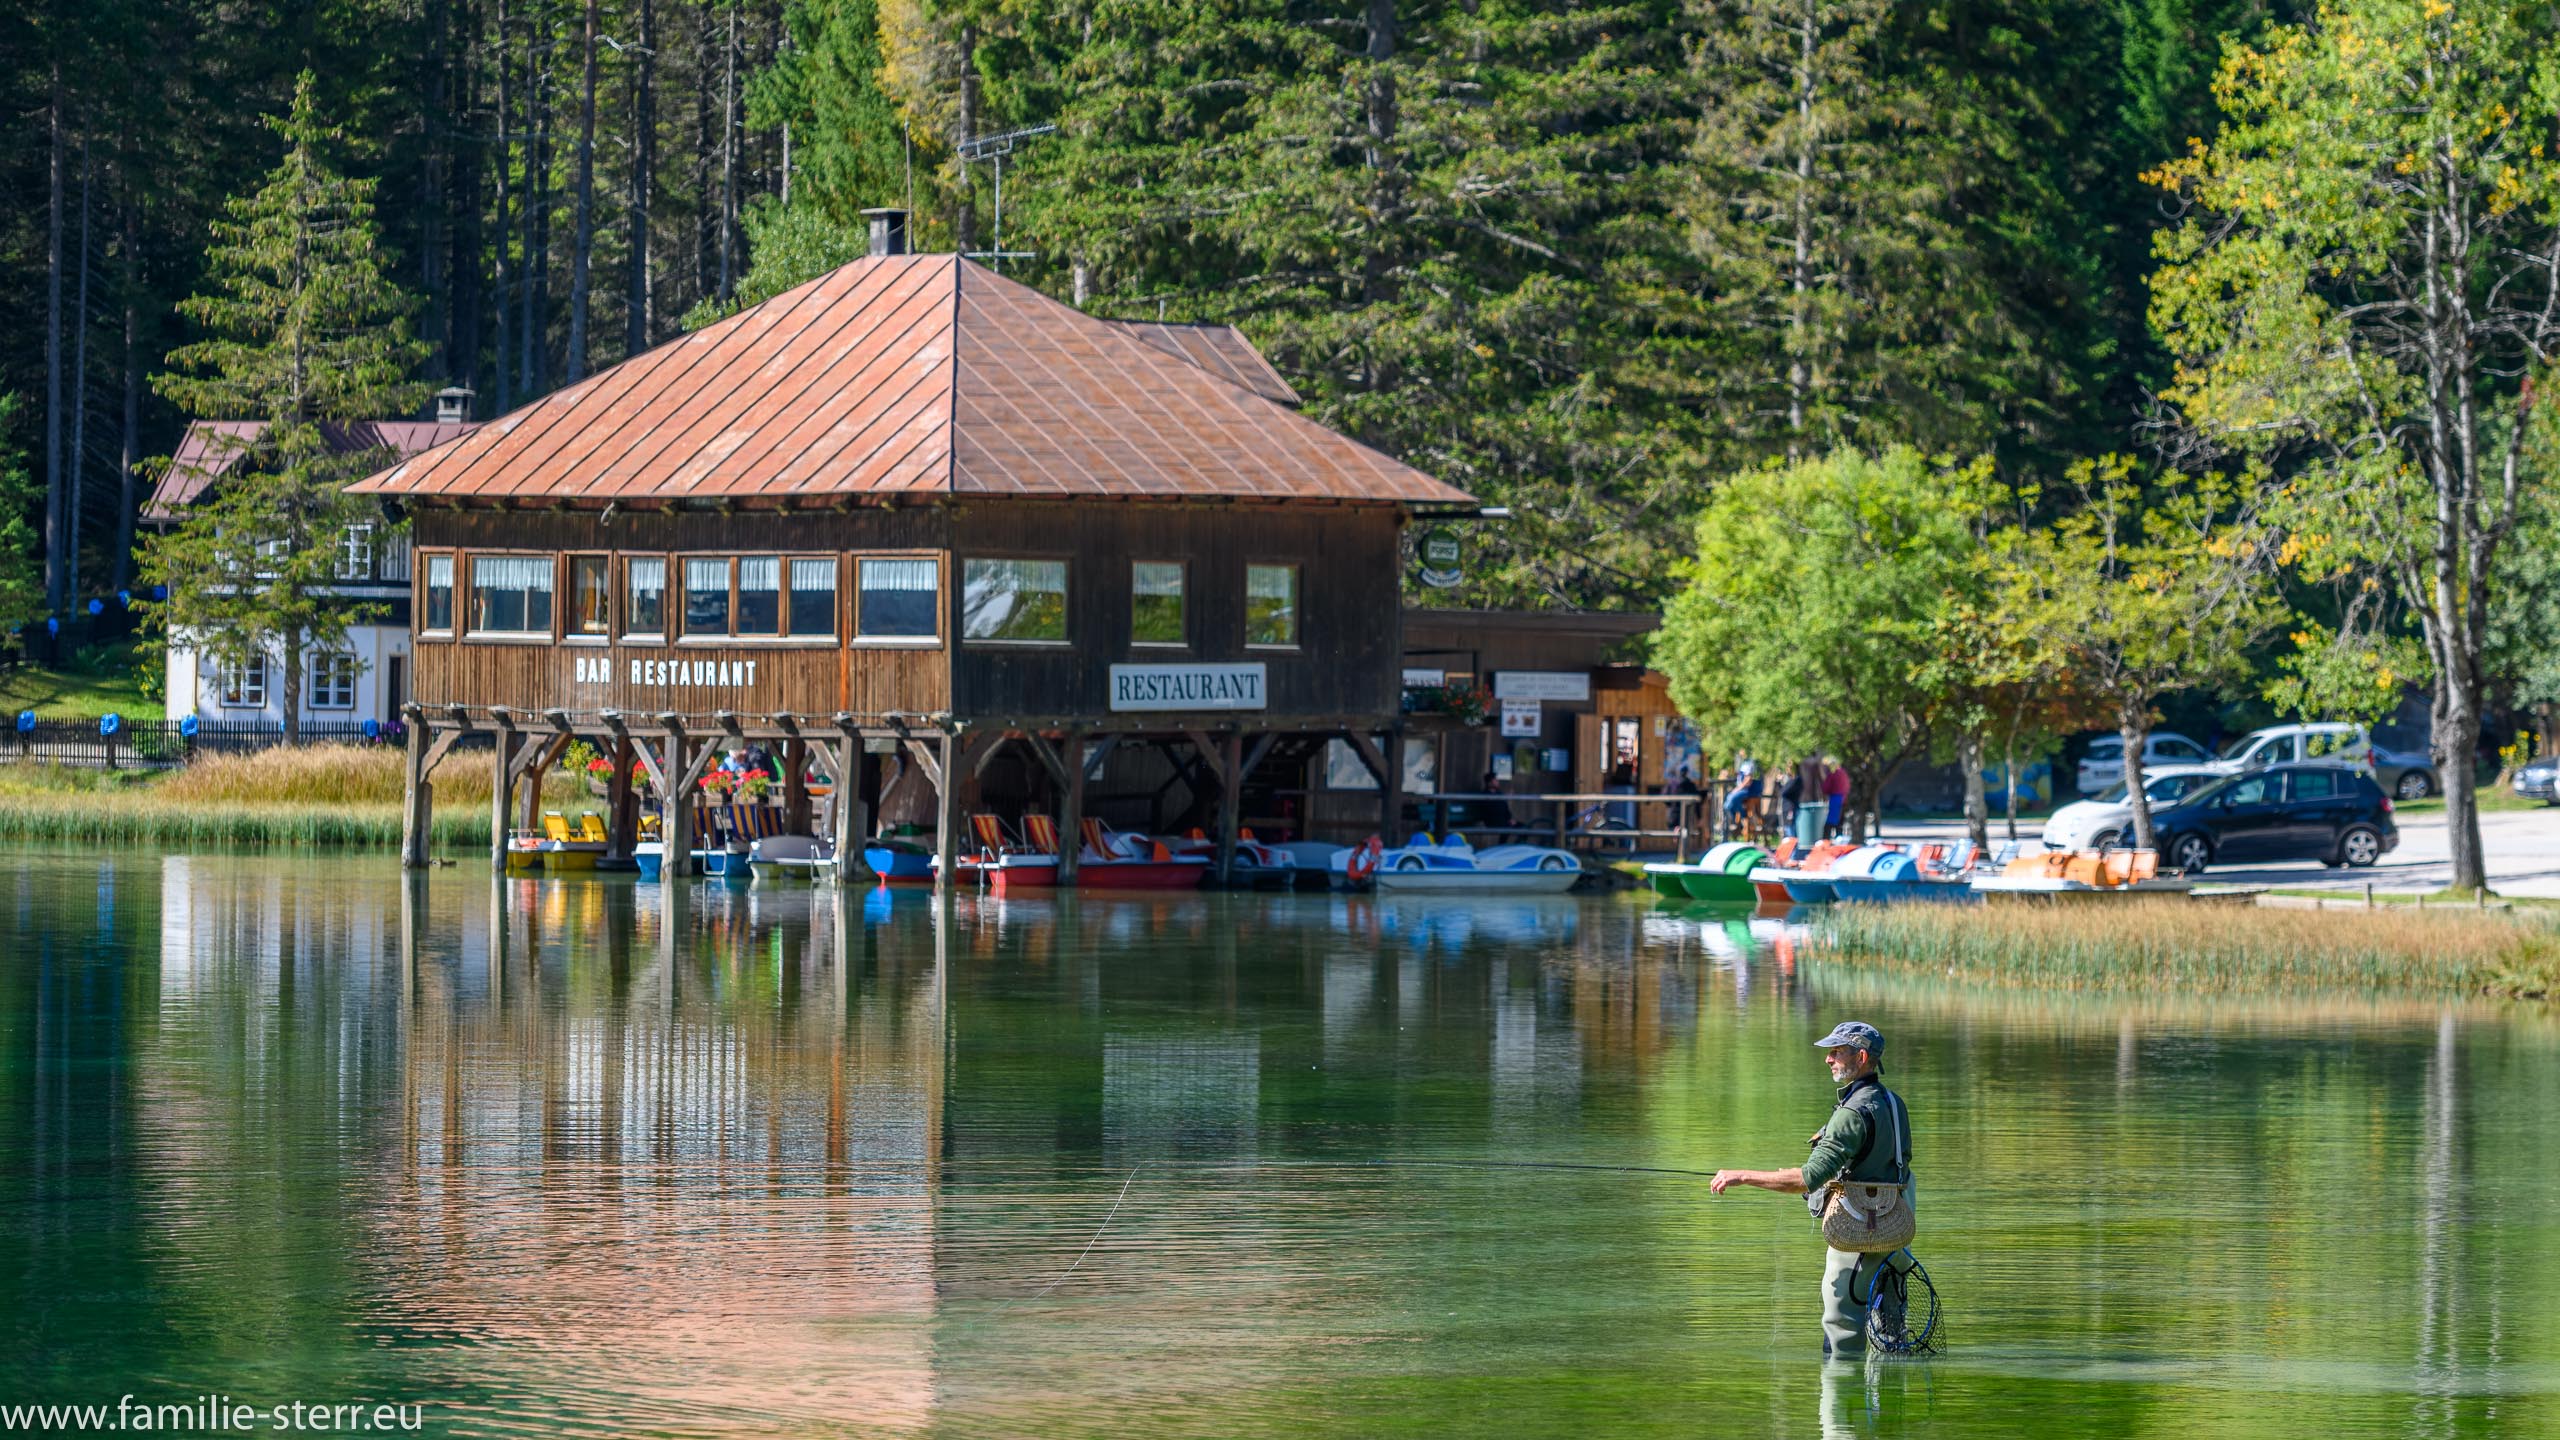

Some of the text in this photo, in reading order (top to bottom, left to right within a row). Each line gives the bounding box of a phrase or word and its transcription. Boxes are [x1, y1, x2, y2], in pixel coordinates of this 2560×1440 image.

[576, 657, 756, 687] BAR RESTAURANT
[1117, 673, 1259, 701] RESTAURANT
